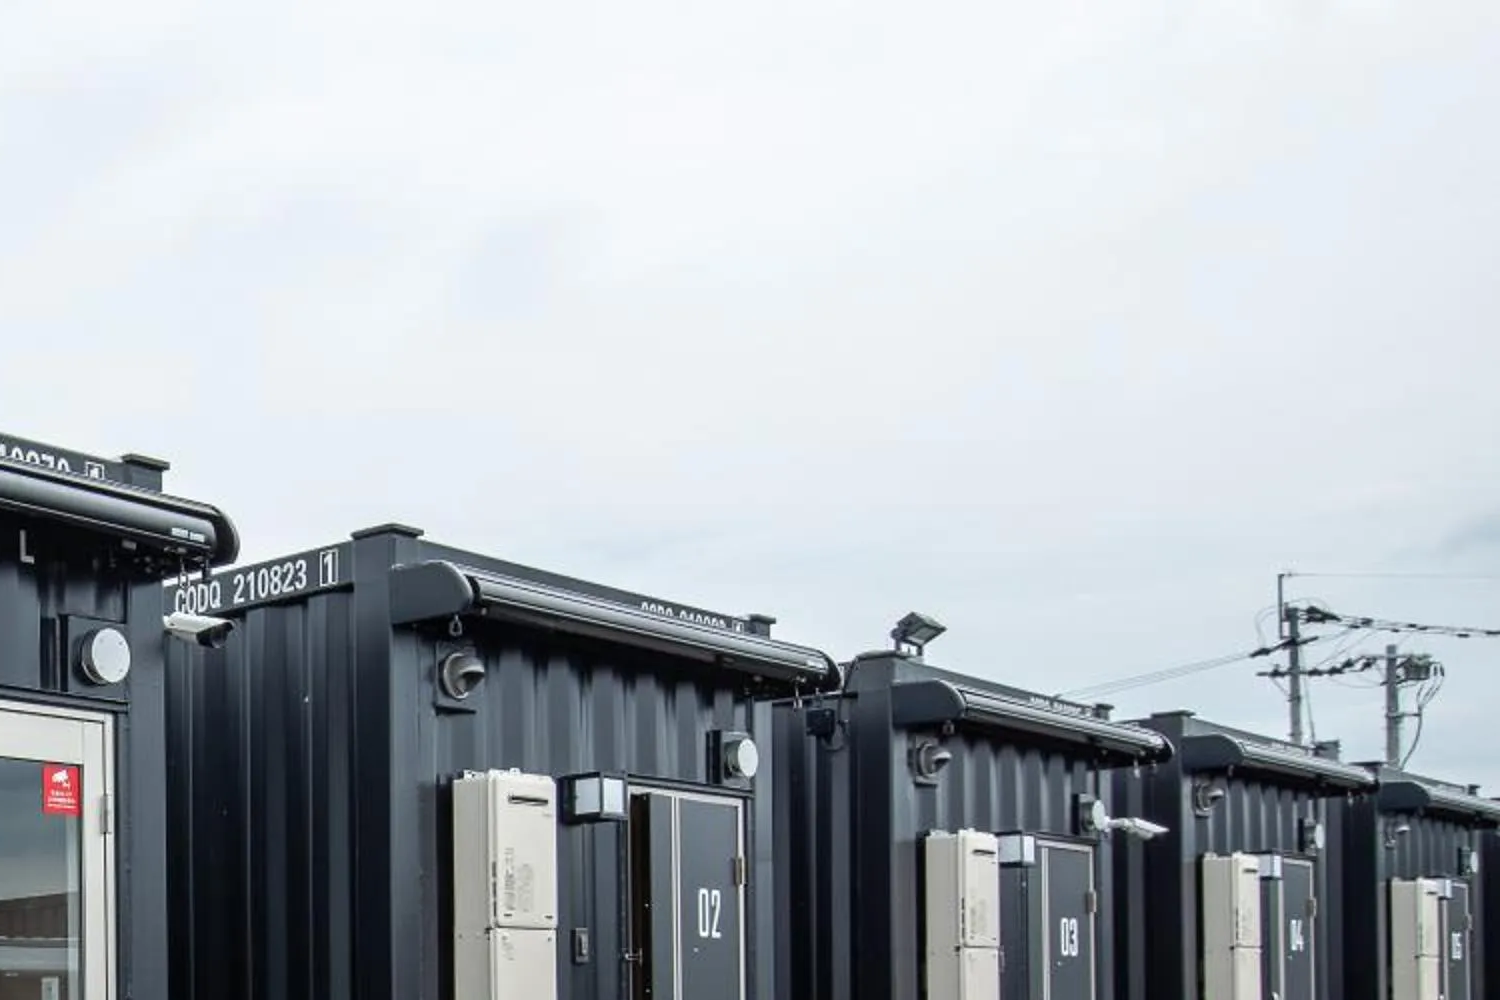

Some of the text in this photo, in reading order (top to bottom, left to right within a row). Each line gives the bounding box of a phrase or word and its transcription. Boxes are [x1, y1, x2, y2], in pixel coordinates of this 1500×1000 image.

[233, 559, 307, 604] 210823
[698, 888, 722, 938] 02
[1060, 917, 1079, 957] 03
